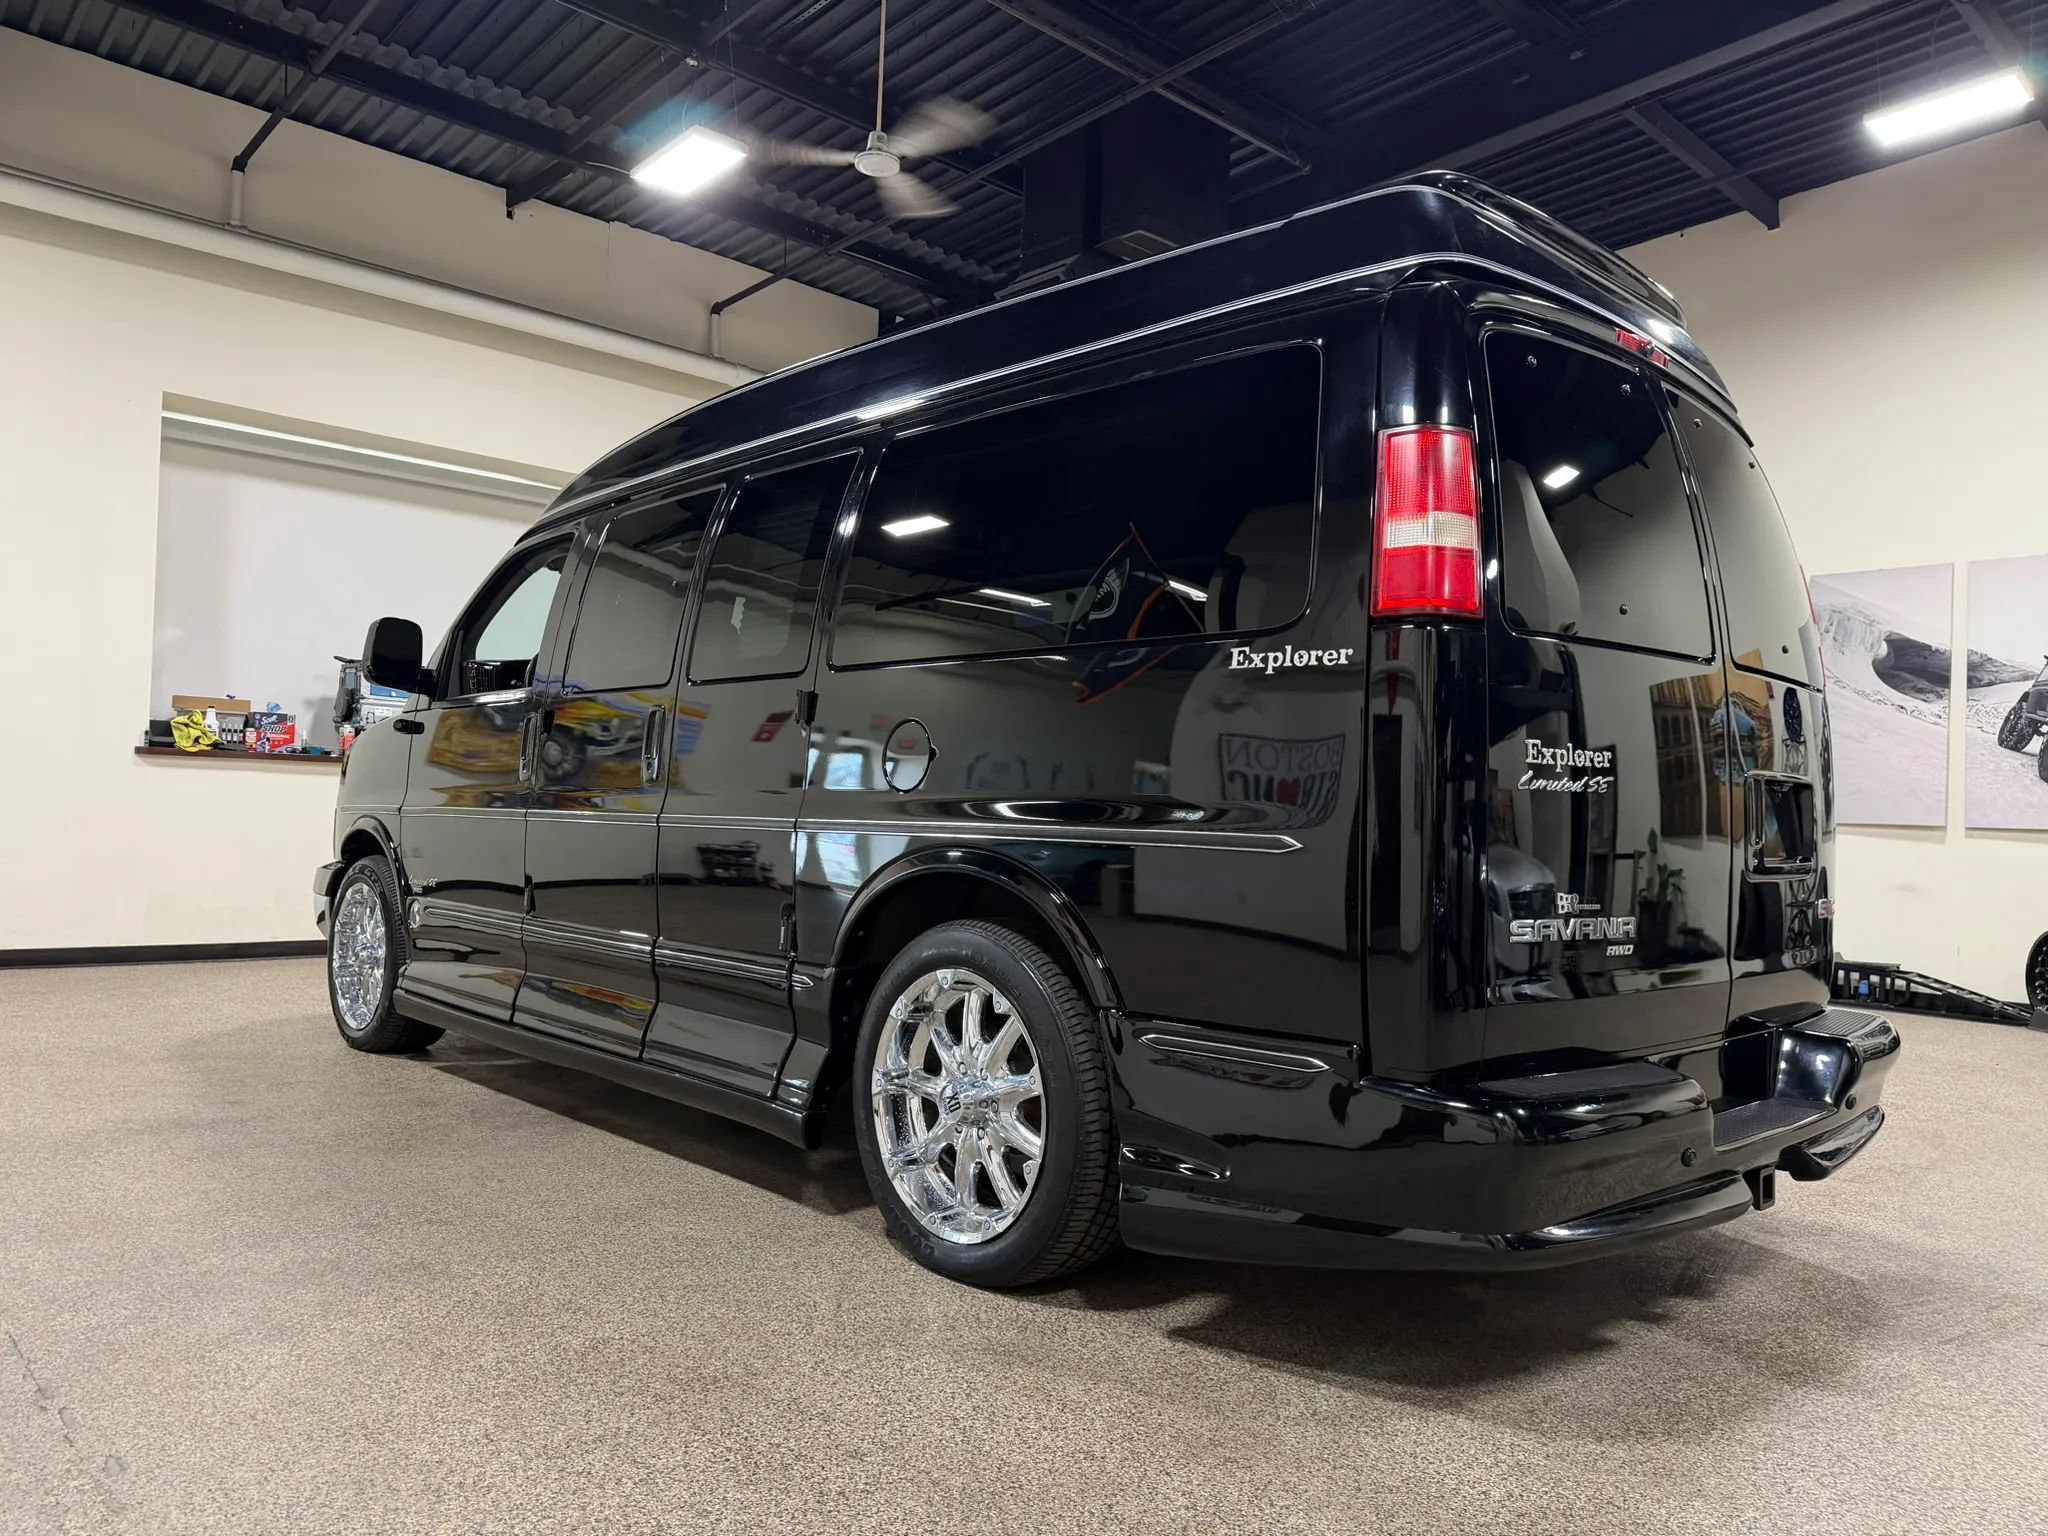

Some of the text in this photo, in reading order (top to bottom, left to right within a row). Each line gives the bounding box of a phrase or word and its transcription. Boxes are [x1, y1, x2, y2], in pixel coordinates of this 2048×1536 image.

[1229, 645, 1353, 674] Explorer
[1525, 739, 1612, 772] Explorer
[1518, 770, 1614, 793] Limited SE
[1510, 917, 1636, 943] SAVANA
[1606, 944, 1634, 956] AWD
[946, 1091, 961, 1113] XD
